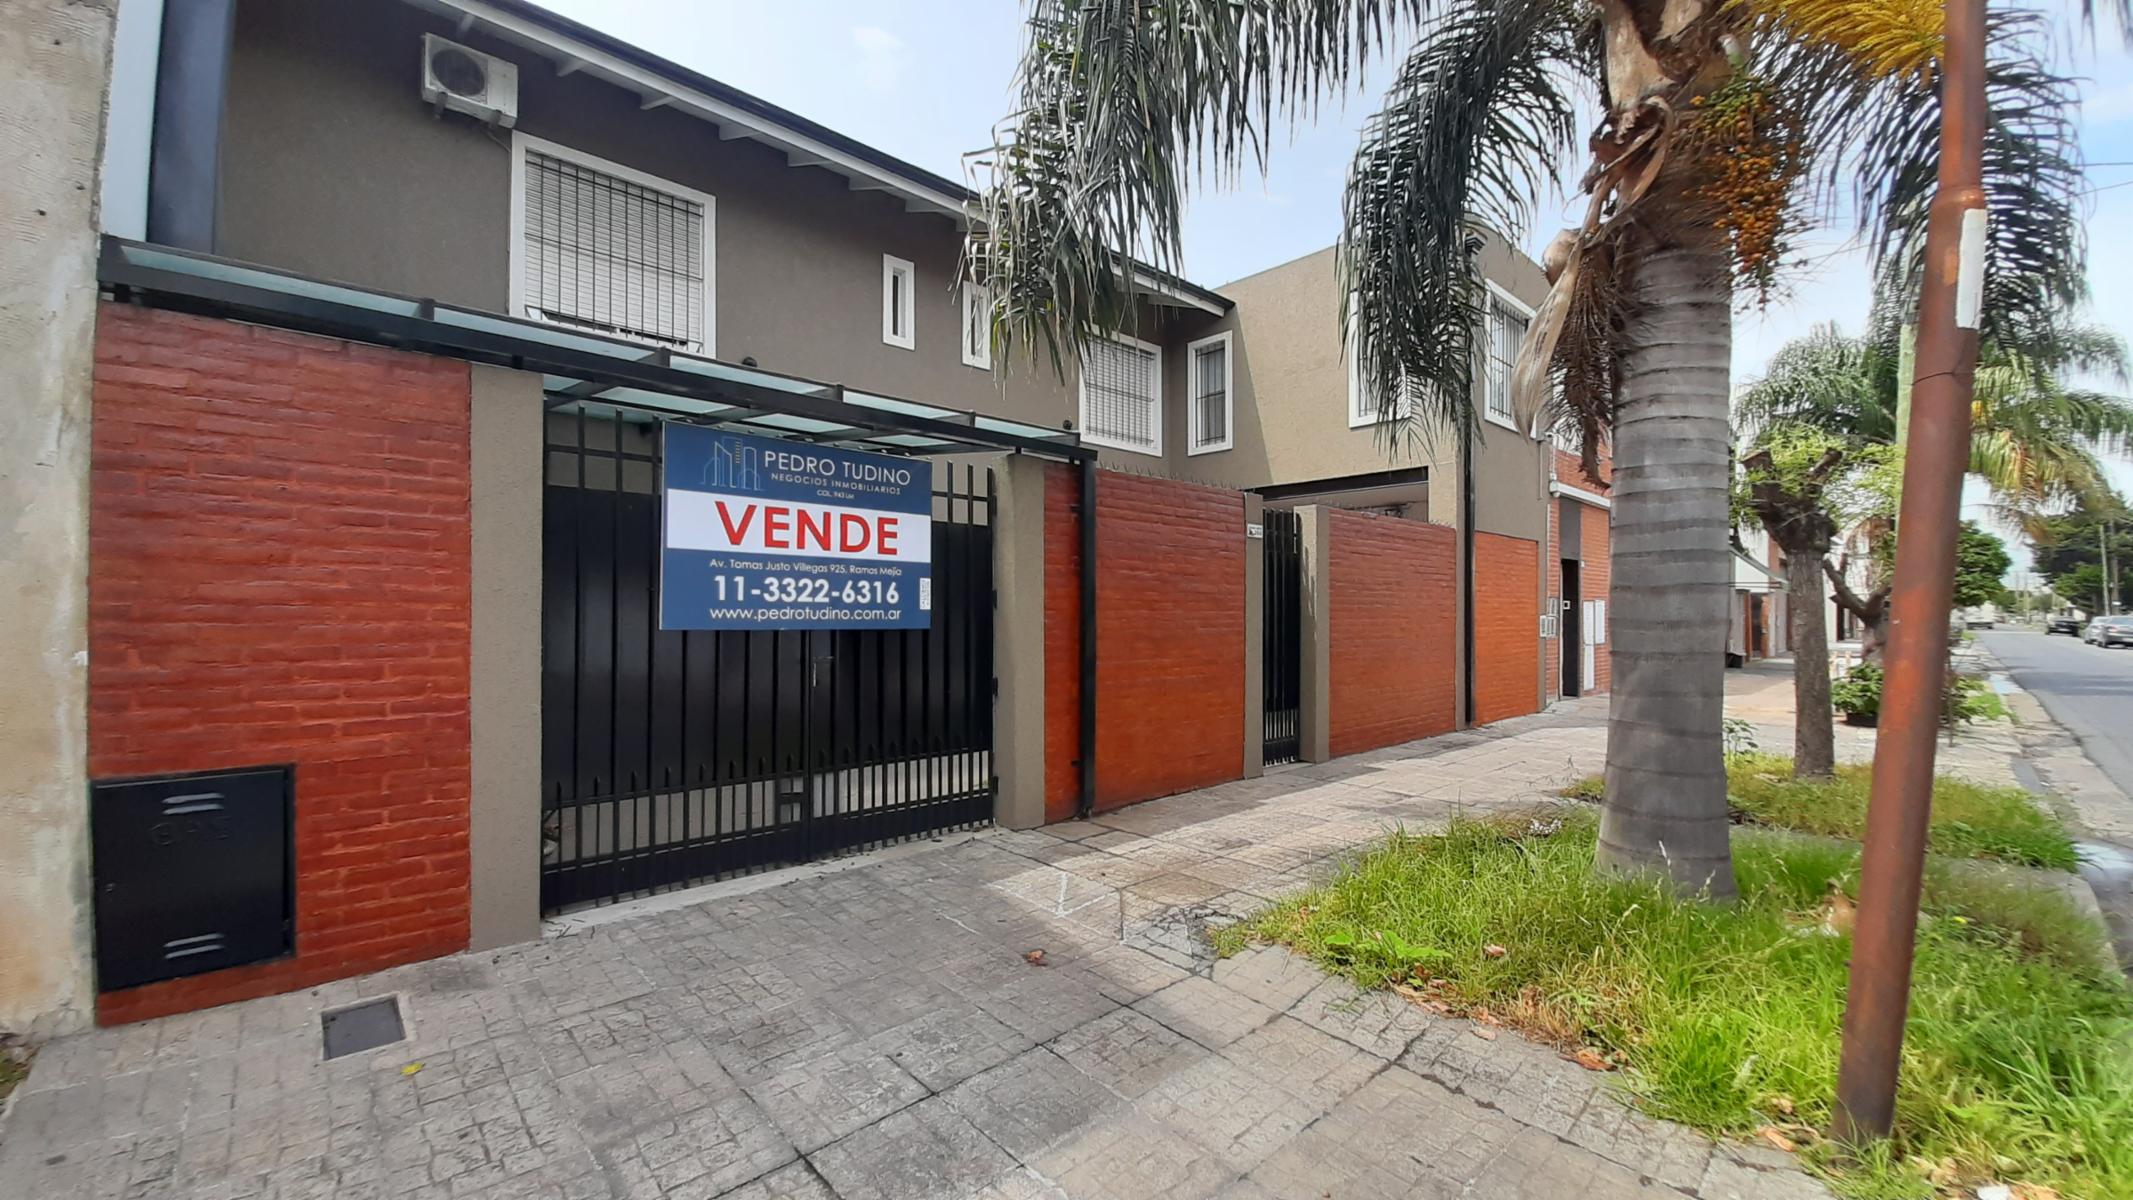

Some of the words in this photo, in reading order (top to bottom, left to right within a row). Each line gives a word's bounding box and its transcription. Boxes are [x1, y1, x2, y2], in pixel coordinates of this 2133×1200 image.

[764, 450, 836, 476] PEDRO
[843, 461, 911, 486] TUDINO
[771, 473, 828, 487] NEGOCIOS
[831, 480, 901, 495] INMOBILIARIOS
[714, 501, 899, 556] VENDE
[709, 558, 727, 569] Av.
[730, 559, 763, 570] Tomas
[765, 562, 791, 571] Justo
[793, 562, 828, 574] Villegas
[850, 565, 878, 575] Ramos
[714, 575, 900, 605] 11-3322-6316
[709, 605, 901, 622] www.pedrotudino.com.ar
